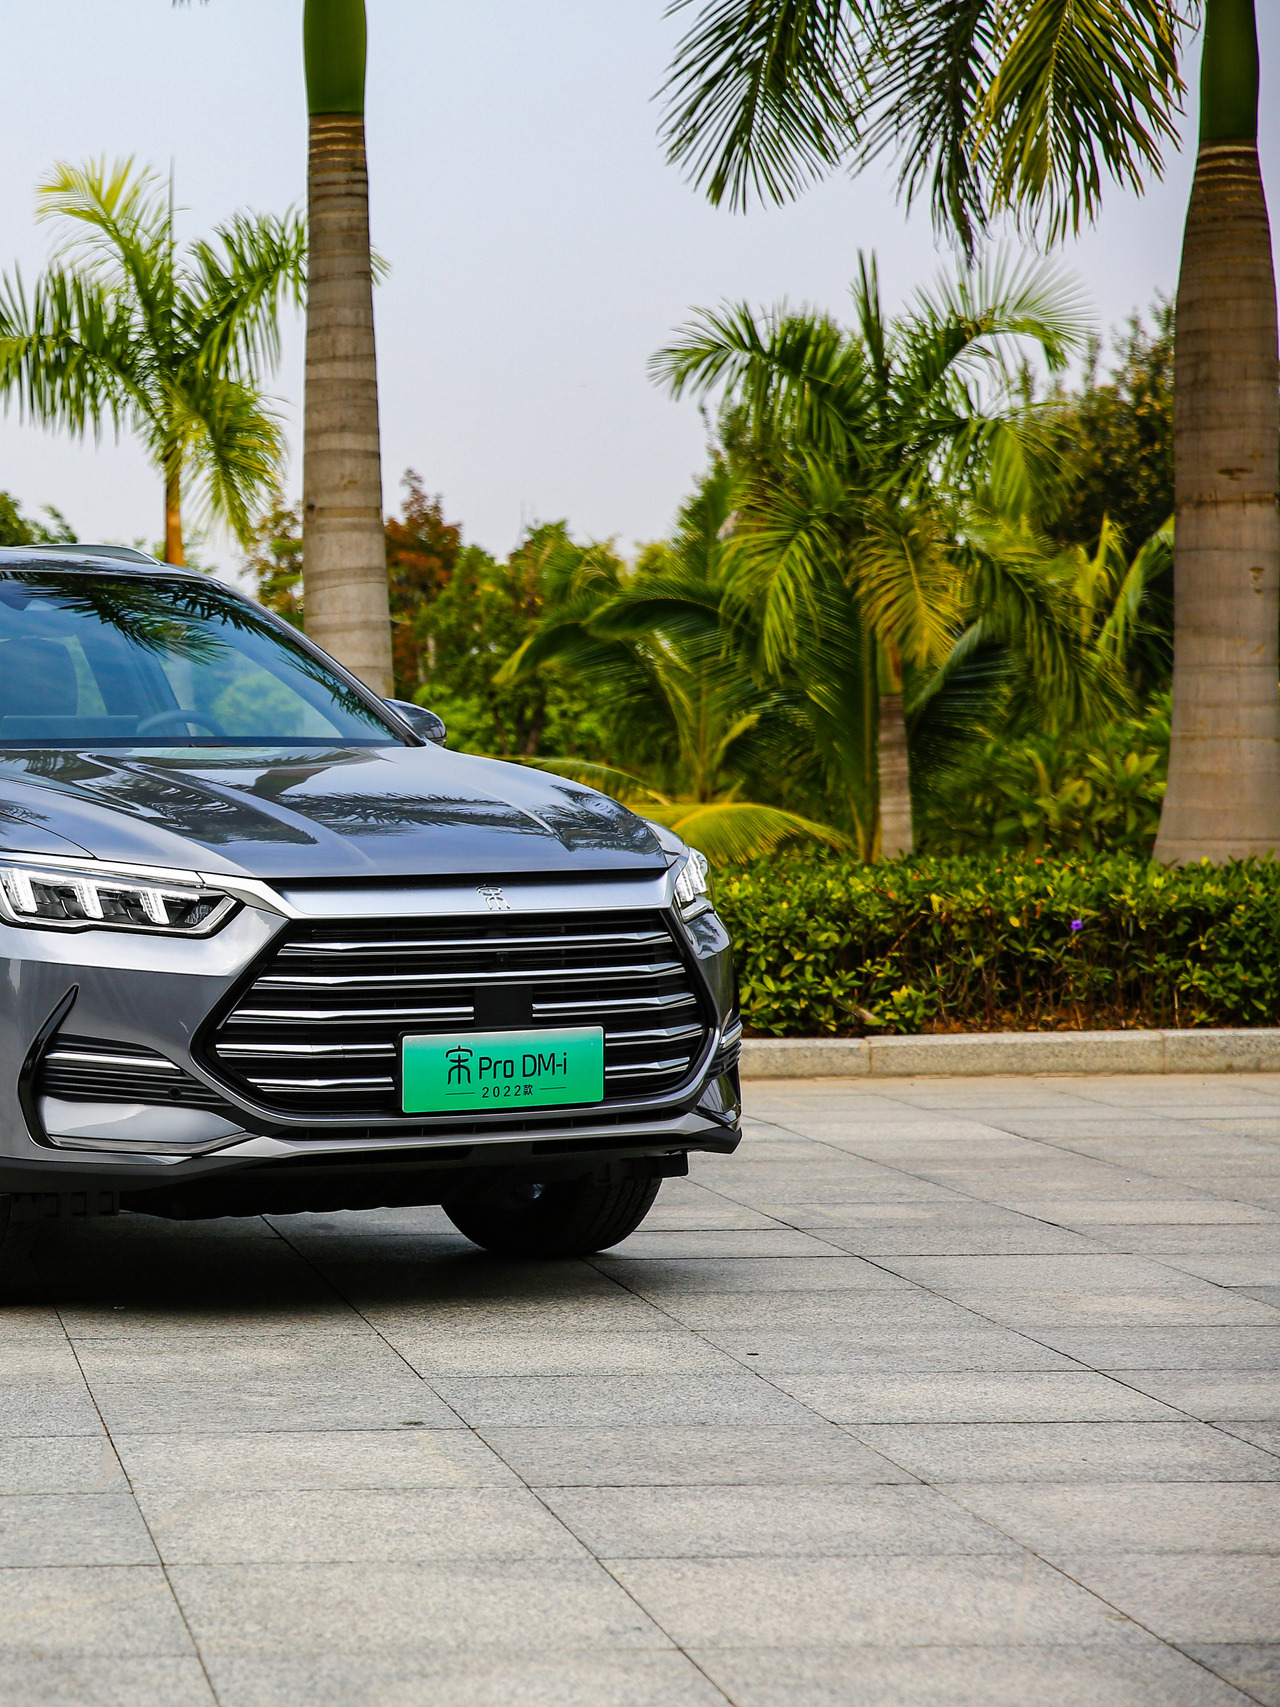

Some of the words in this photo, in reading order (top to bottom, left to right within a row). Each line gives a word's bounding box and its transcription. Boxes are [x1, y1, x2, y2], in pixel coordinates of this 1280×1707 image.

[478, 1056, 515, 1080] Pro
[522, 1052, 567, 1078] DM-i
[482, 1084, 533, 1098] 2022款
